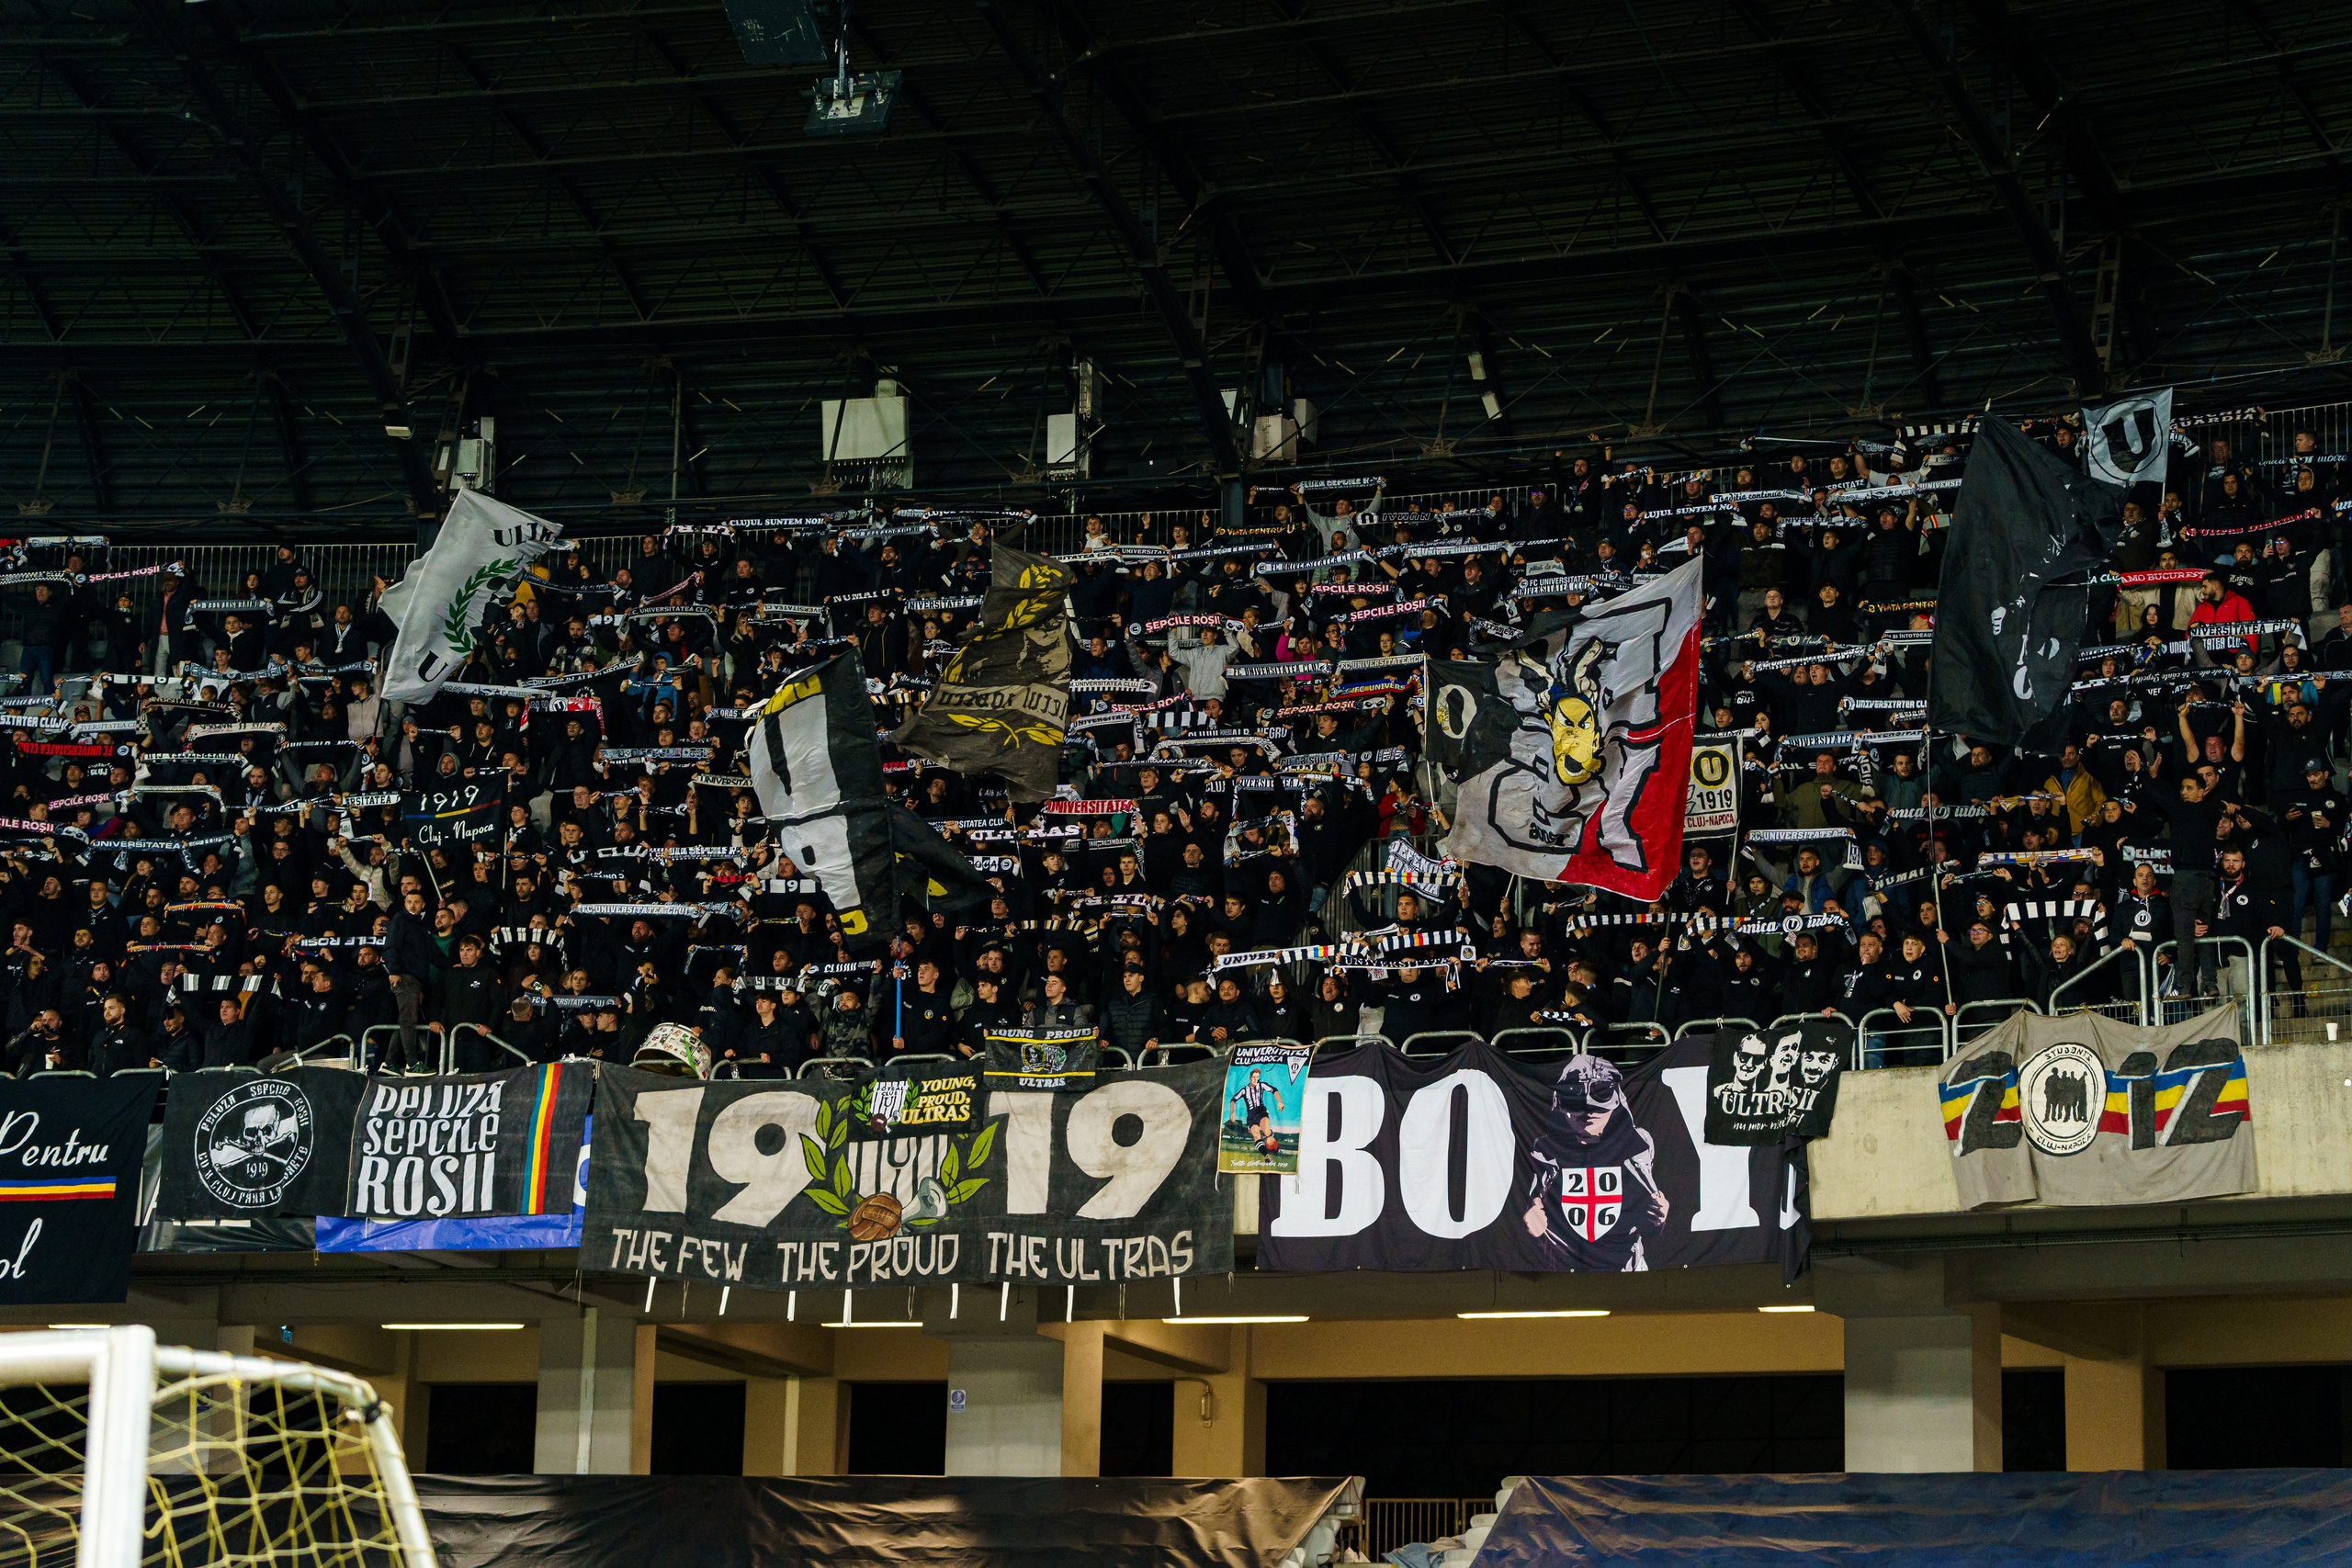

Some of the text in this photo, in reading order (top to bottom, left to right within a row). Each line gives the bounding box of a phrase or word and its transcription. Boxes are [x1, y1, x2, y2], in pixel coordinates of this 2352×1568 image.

[729, 519, 764, 527] CLUJUL
[764, 517, 803, 526] SUNTEM
[40, 716, 62, 729] CLUJ
[1700, 757, 1722, 782] U
[420, 784, 481, 812] 1919
[1696, 788, 1733, 810] 1919
[93, 840, 181, 851] UNIVERSITATEA
[989, 1027, 1092, 1040] YOUNG PROUD
[1236, 1045, 1311, 1058] UNIVERSITATEA
[921, 1075, 977, 1093] YOUNG,
[1019, 1077, 1067, 1089] ULTRAS
[918, 1090, 971, 1109] PROUD,
[901, 1104, 971, 1125] ULTRAS
[245, 1161, 270, 1179] 1919
[611, 1227, 1193, 1282] THE FEW THE PROUD THE ULTRAS
